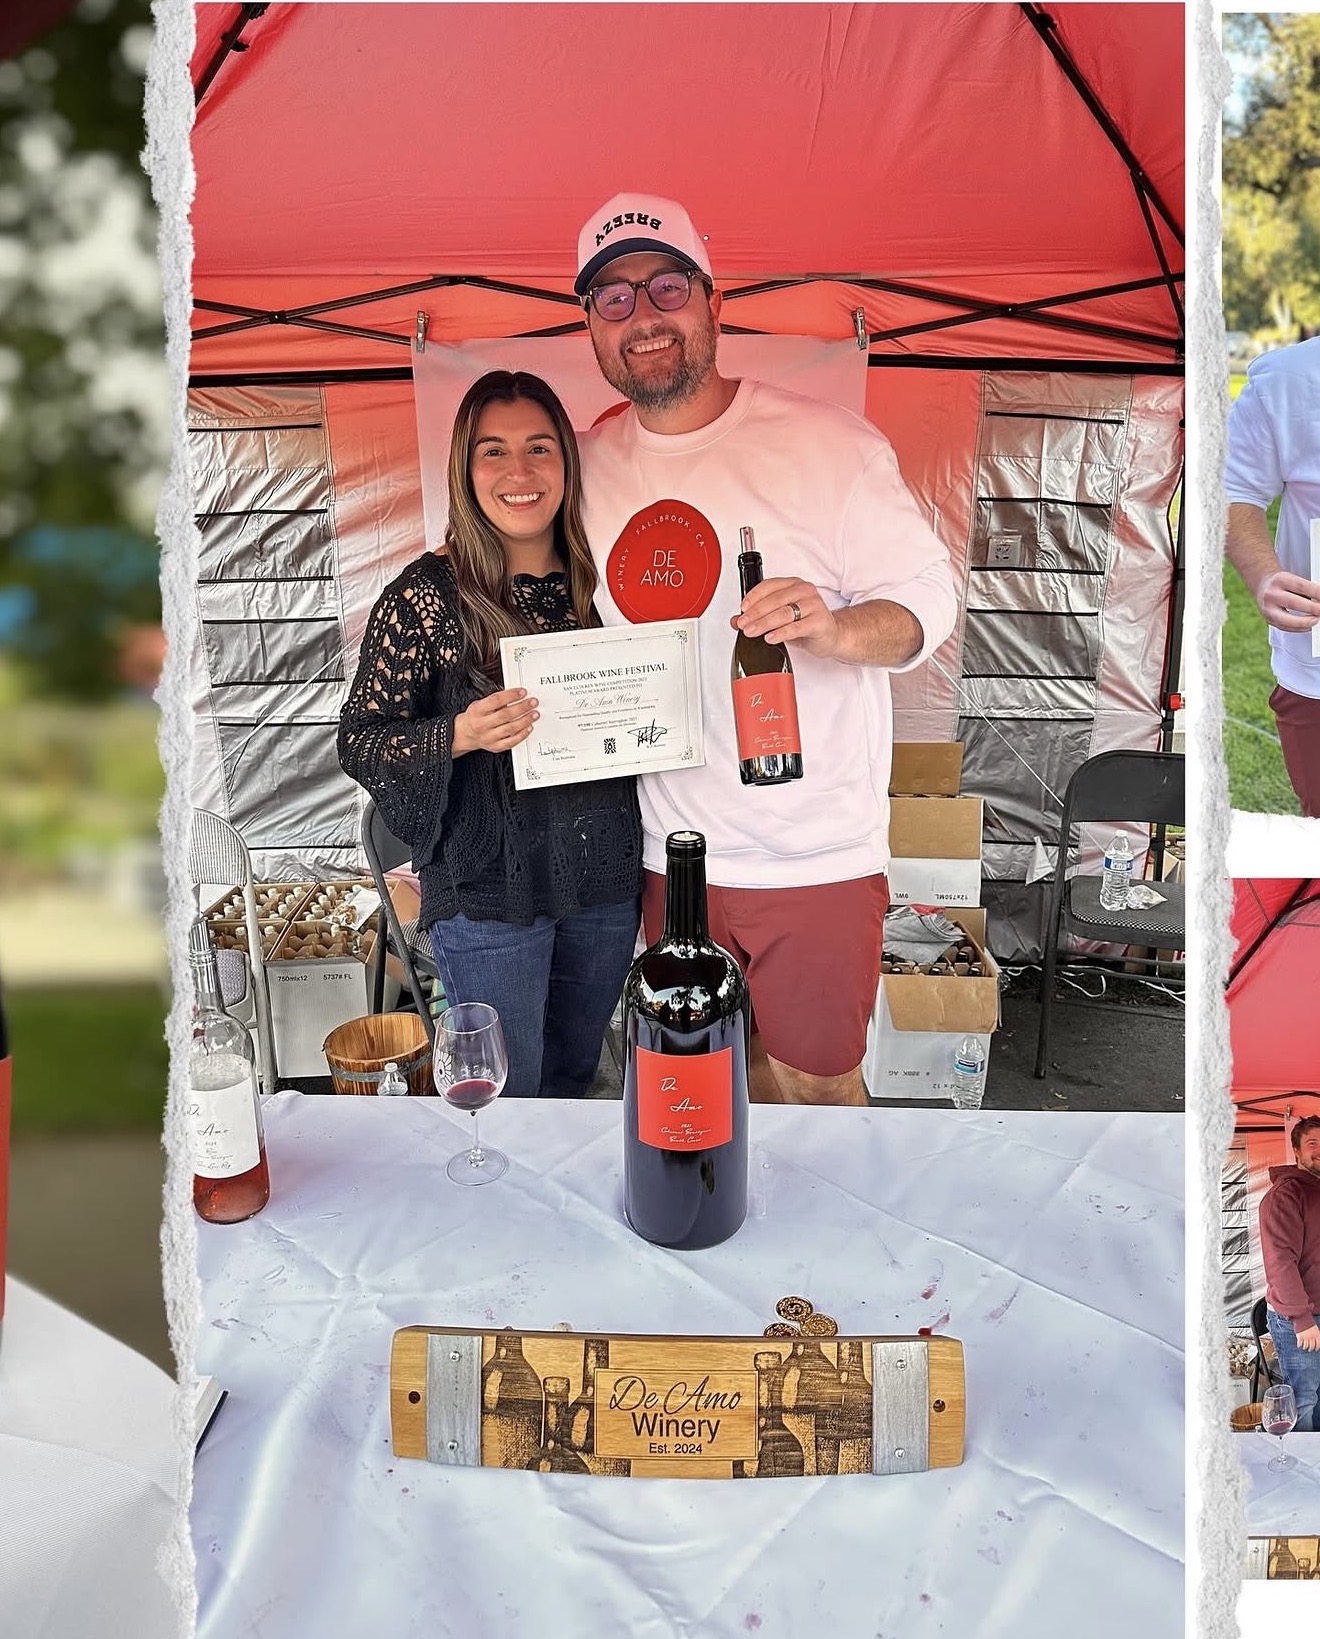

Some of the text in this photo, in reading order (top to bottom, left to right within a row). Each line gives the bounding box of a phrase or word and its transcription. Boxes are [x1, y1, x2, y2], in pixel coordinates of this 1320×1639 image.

[595, 212, 662, 247] BREEZY
[618, 548, 629, 591] WINERY
[695, 533, 705, 547] CA
[653, 550, 677, 567] DE
[640, 569, 684, 587] AMO
[540, 663, 668, 685] FALLBROOK WINE FESTIVAL
[614, 692, 641, 703] Winery
[661, 1077, 678, 1091] De
[670, 1097, 703, 1112] Amo
[609, 1375, 743, 1414] De Amo
[631, 1412, 721, 1444] Winery
[649, 1443, 703, 1454] Est. 2024
